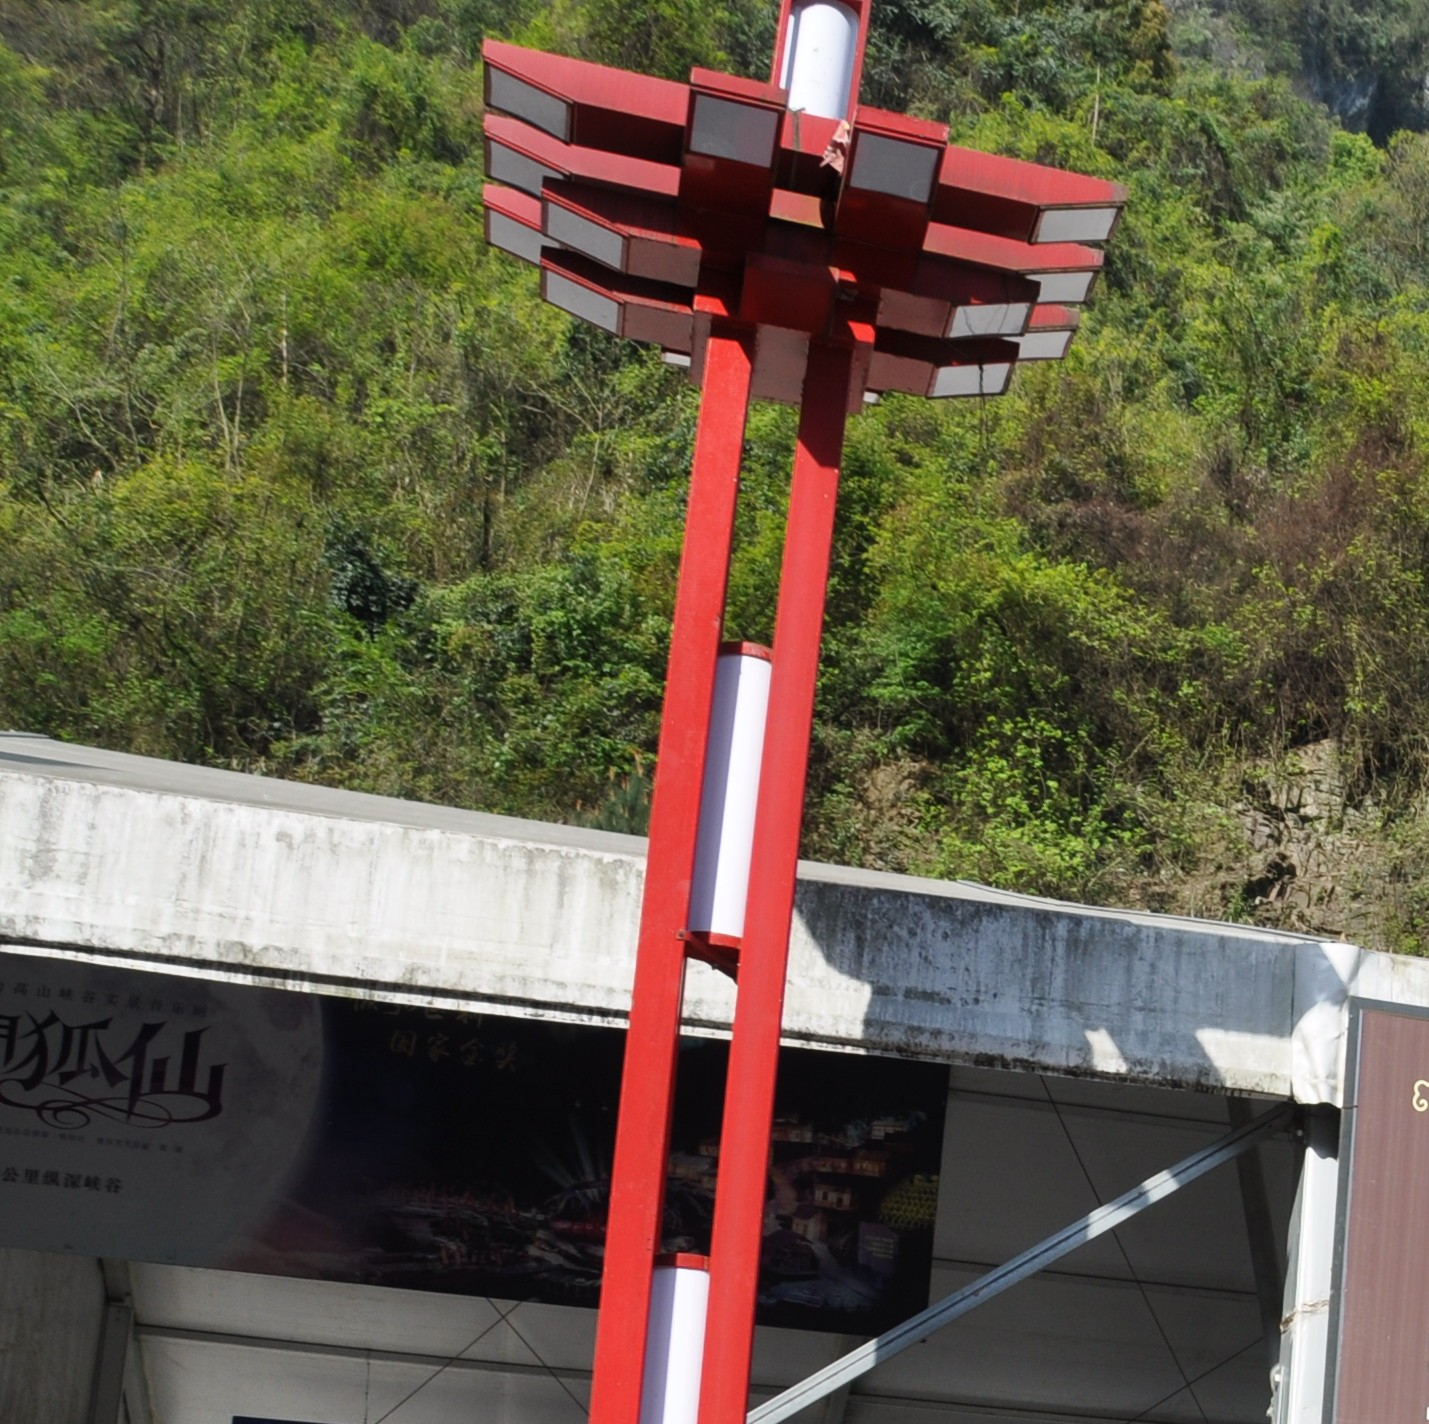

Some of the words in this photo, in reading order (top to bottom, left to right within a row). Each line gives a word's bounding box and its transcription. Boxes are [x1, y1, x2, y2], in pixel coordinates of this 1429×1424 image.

[0, 980, 208, 1018] 高山峡谷实景音乐剧
